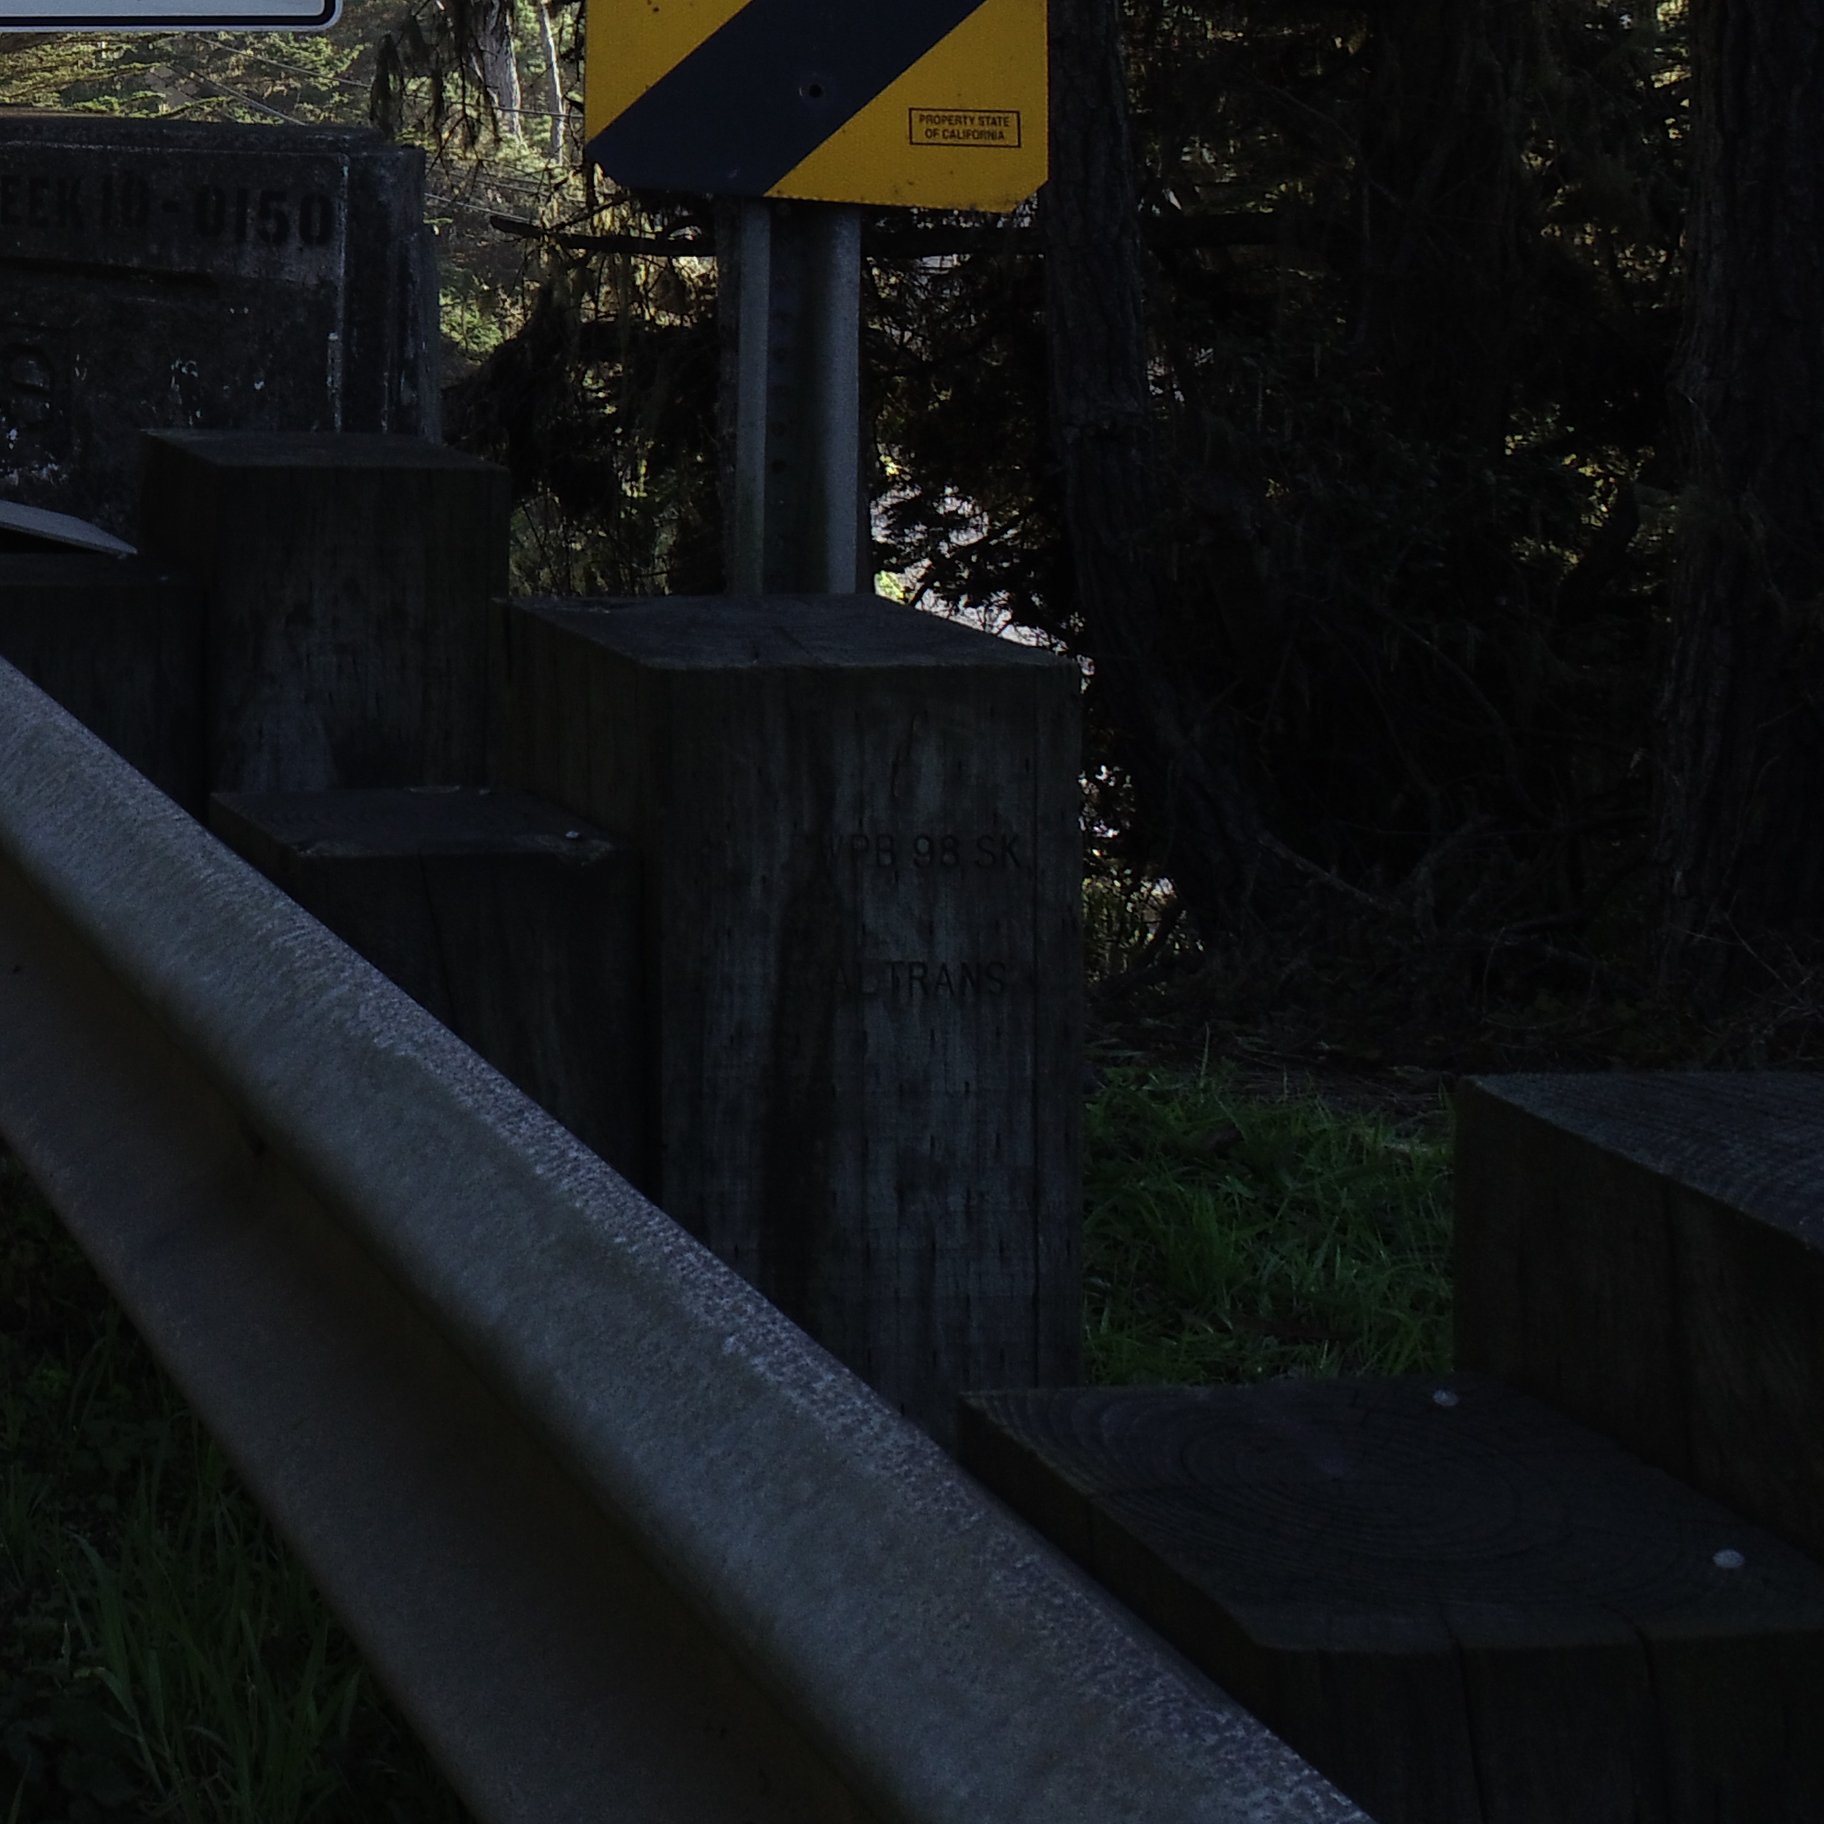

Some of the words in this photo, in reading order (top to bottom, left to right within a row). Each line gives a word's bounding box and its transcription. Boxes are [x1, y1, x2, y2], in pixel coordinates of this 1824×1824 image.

[918, 113, 975, 126] PROPERTY
[978, 115, 1010, 127] STATE
[924, 128, 939, 139] OF
[942, 128, 1005, 140] CALIFORNIA
[913, 833, 960, 869] 98
[973, 833, 1023, 869] SK
